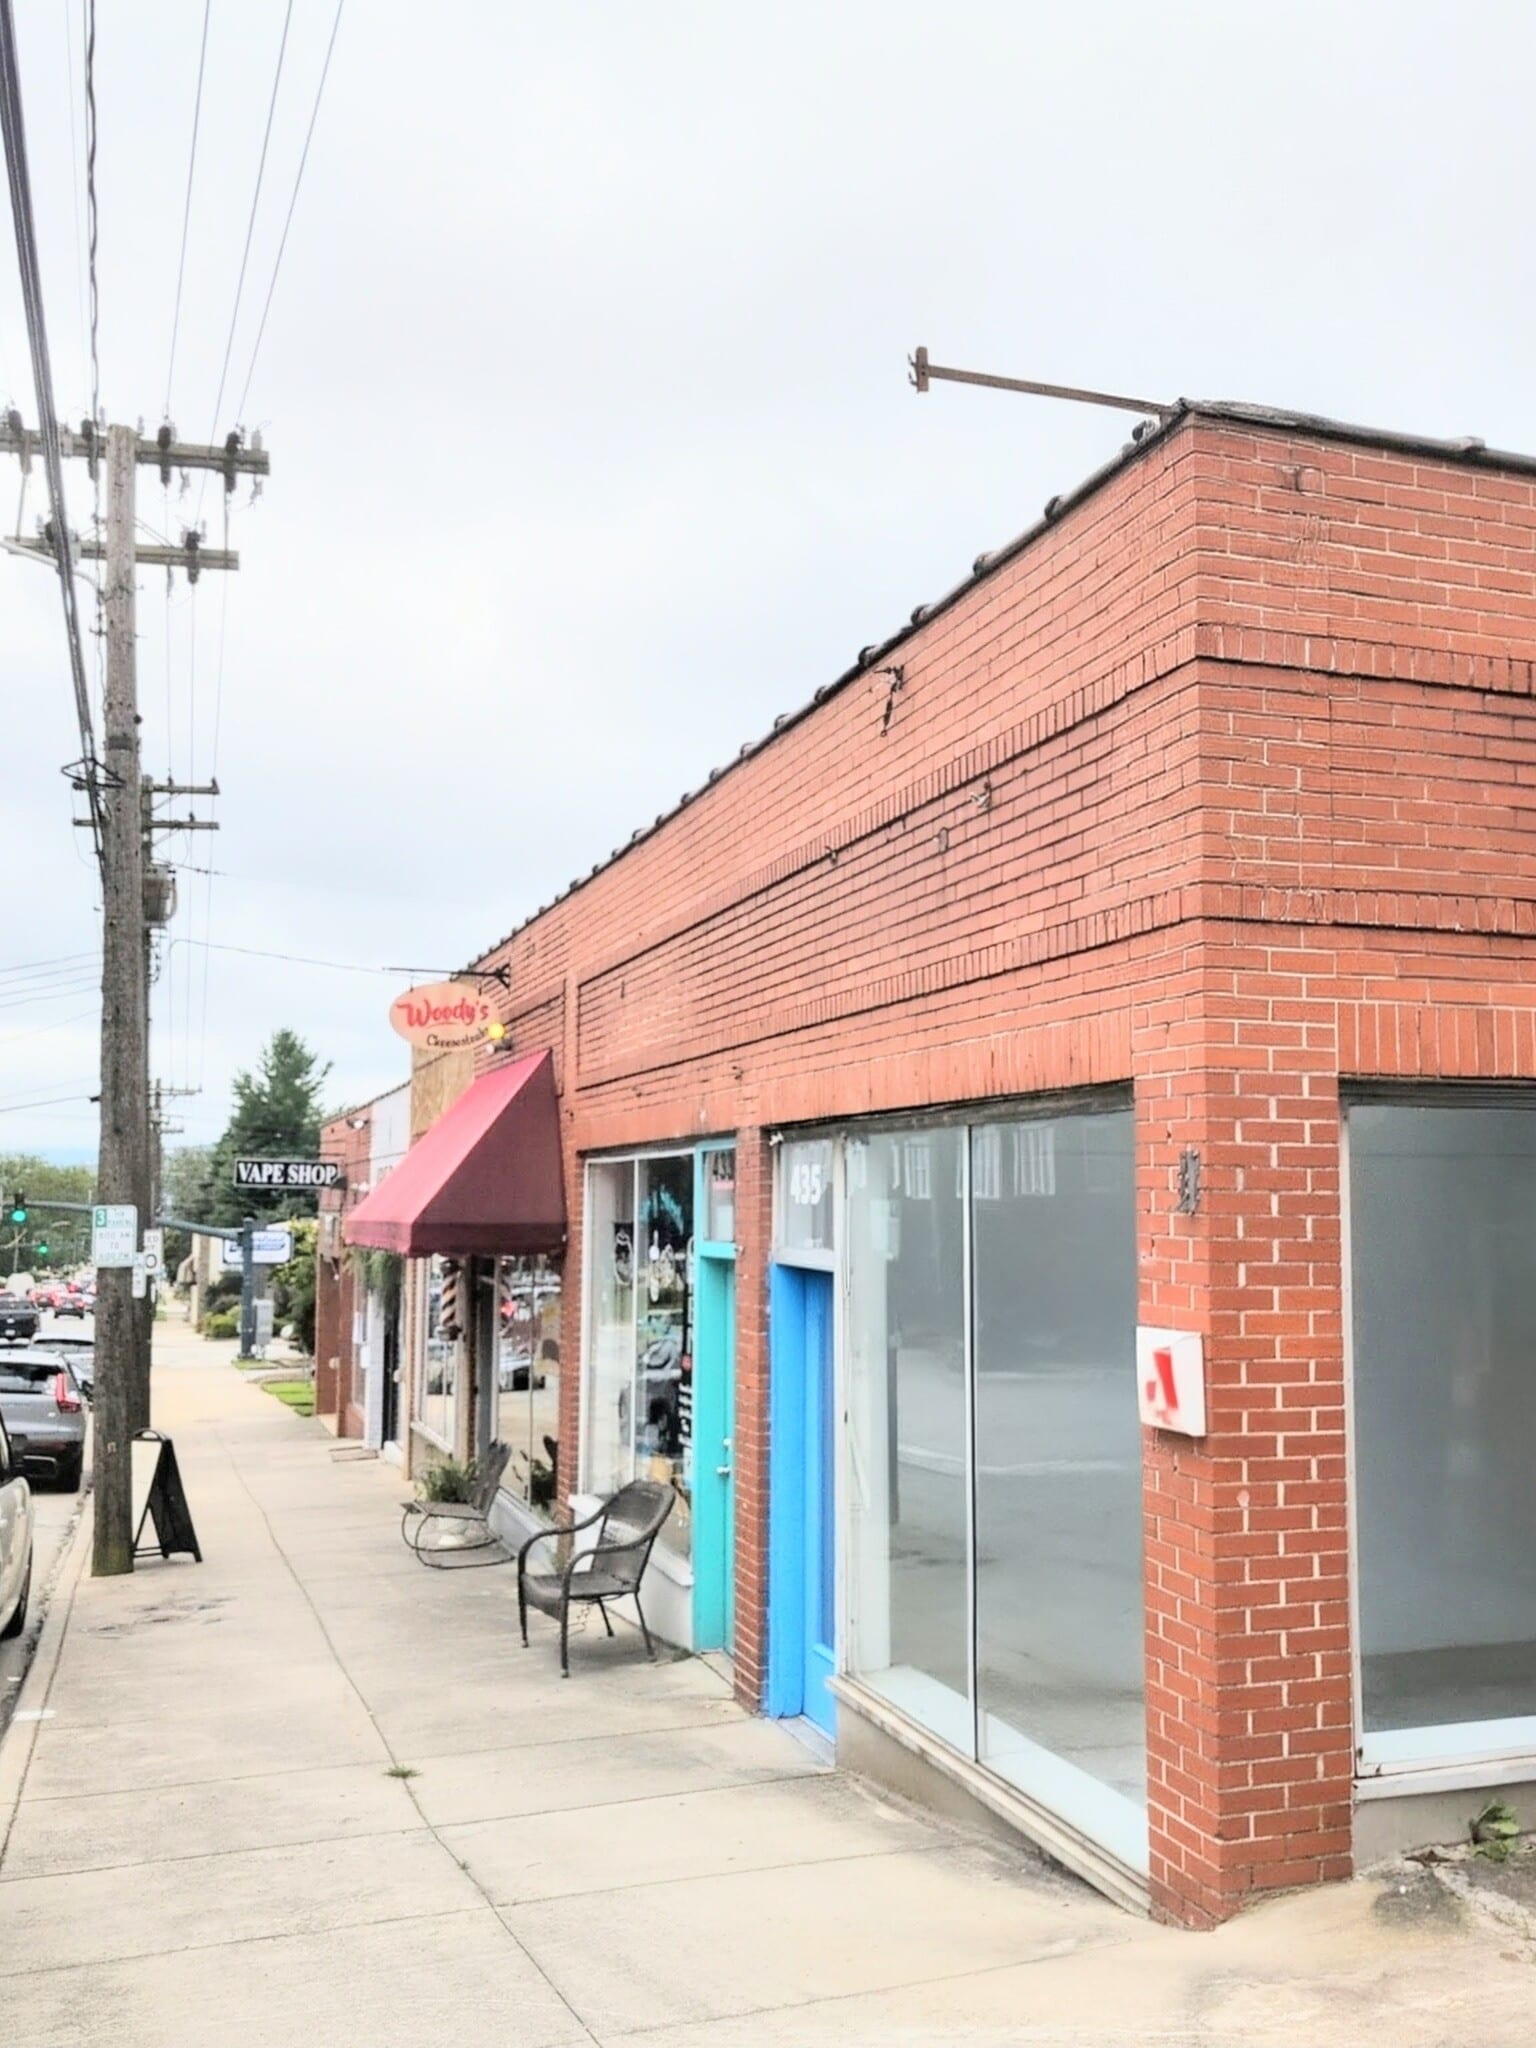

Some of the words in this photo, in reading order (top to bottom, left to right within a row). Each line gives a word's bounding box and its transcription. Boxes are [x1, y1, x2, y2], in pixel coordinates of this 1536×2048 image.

[397, 997, 489, 1027] Woody's
[238, 1162, 285, 1183] VAPE
[287, 1164, 337, 1185] SHOP
[790, 1164, 822, 1205] 435
[97, 1210, 105, 1225] 3
